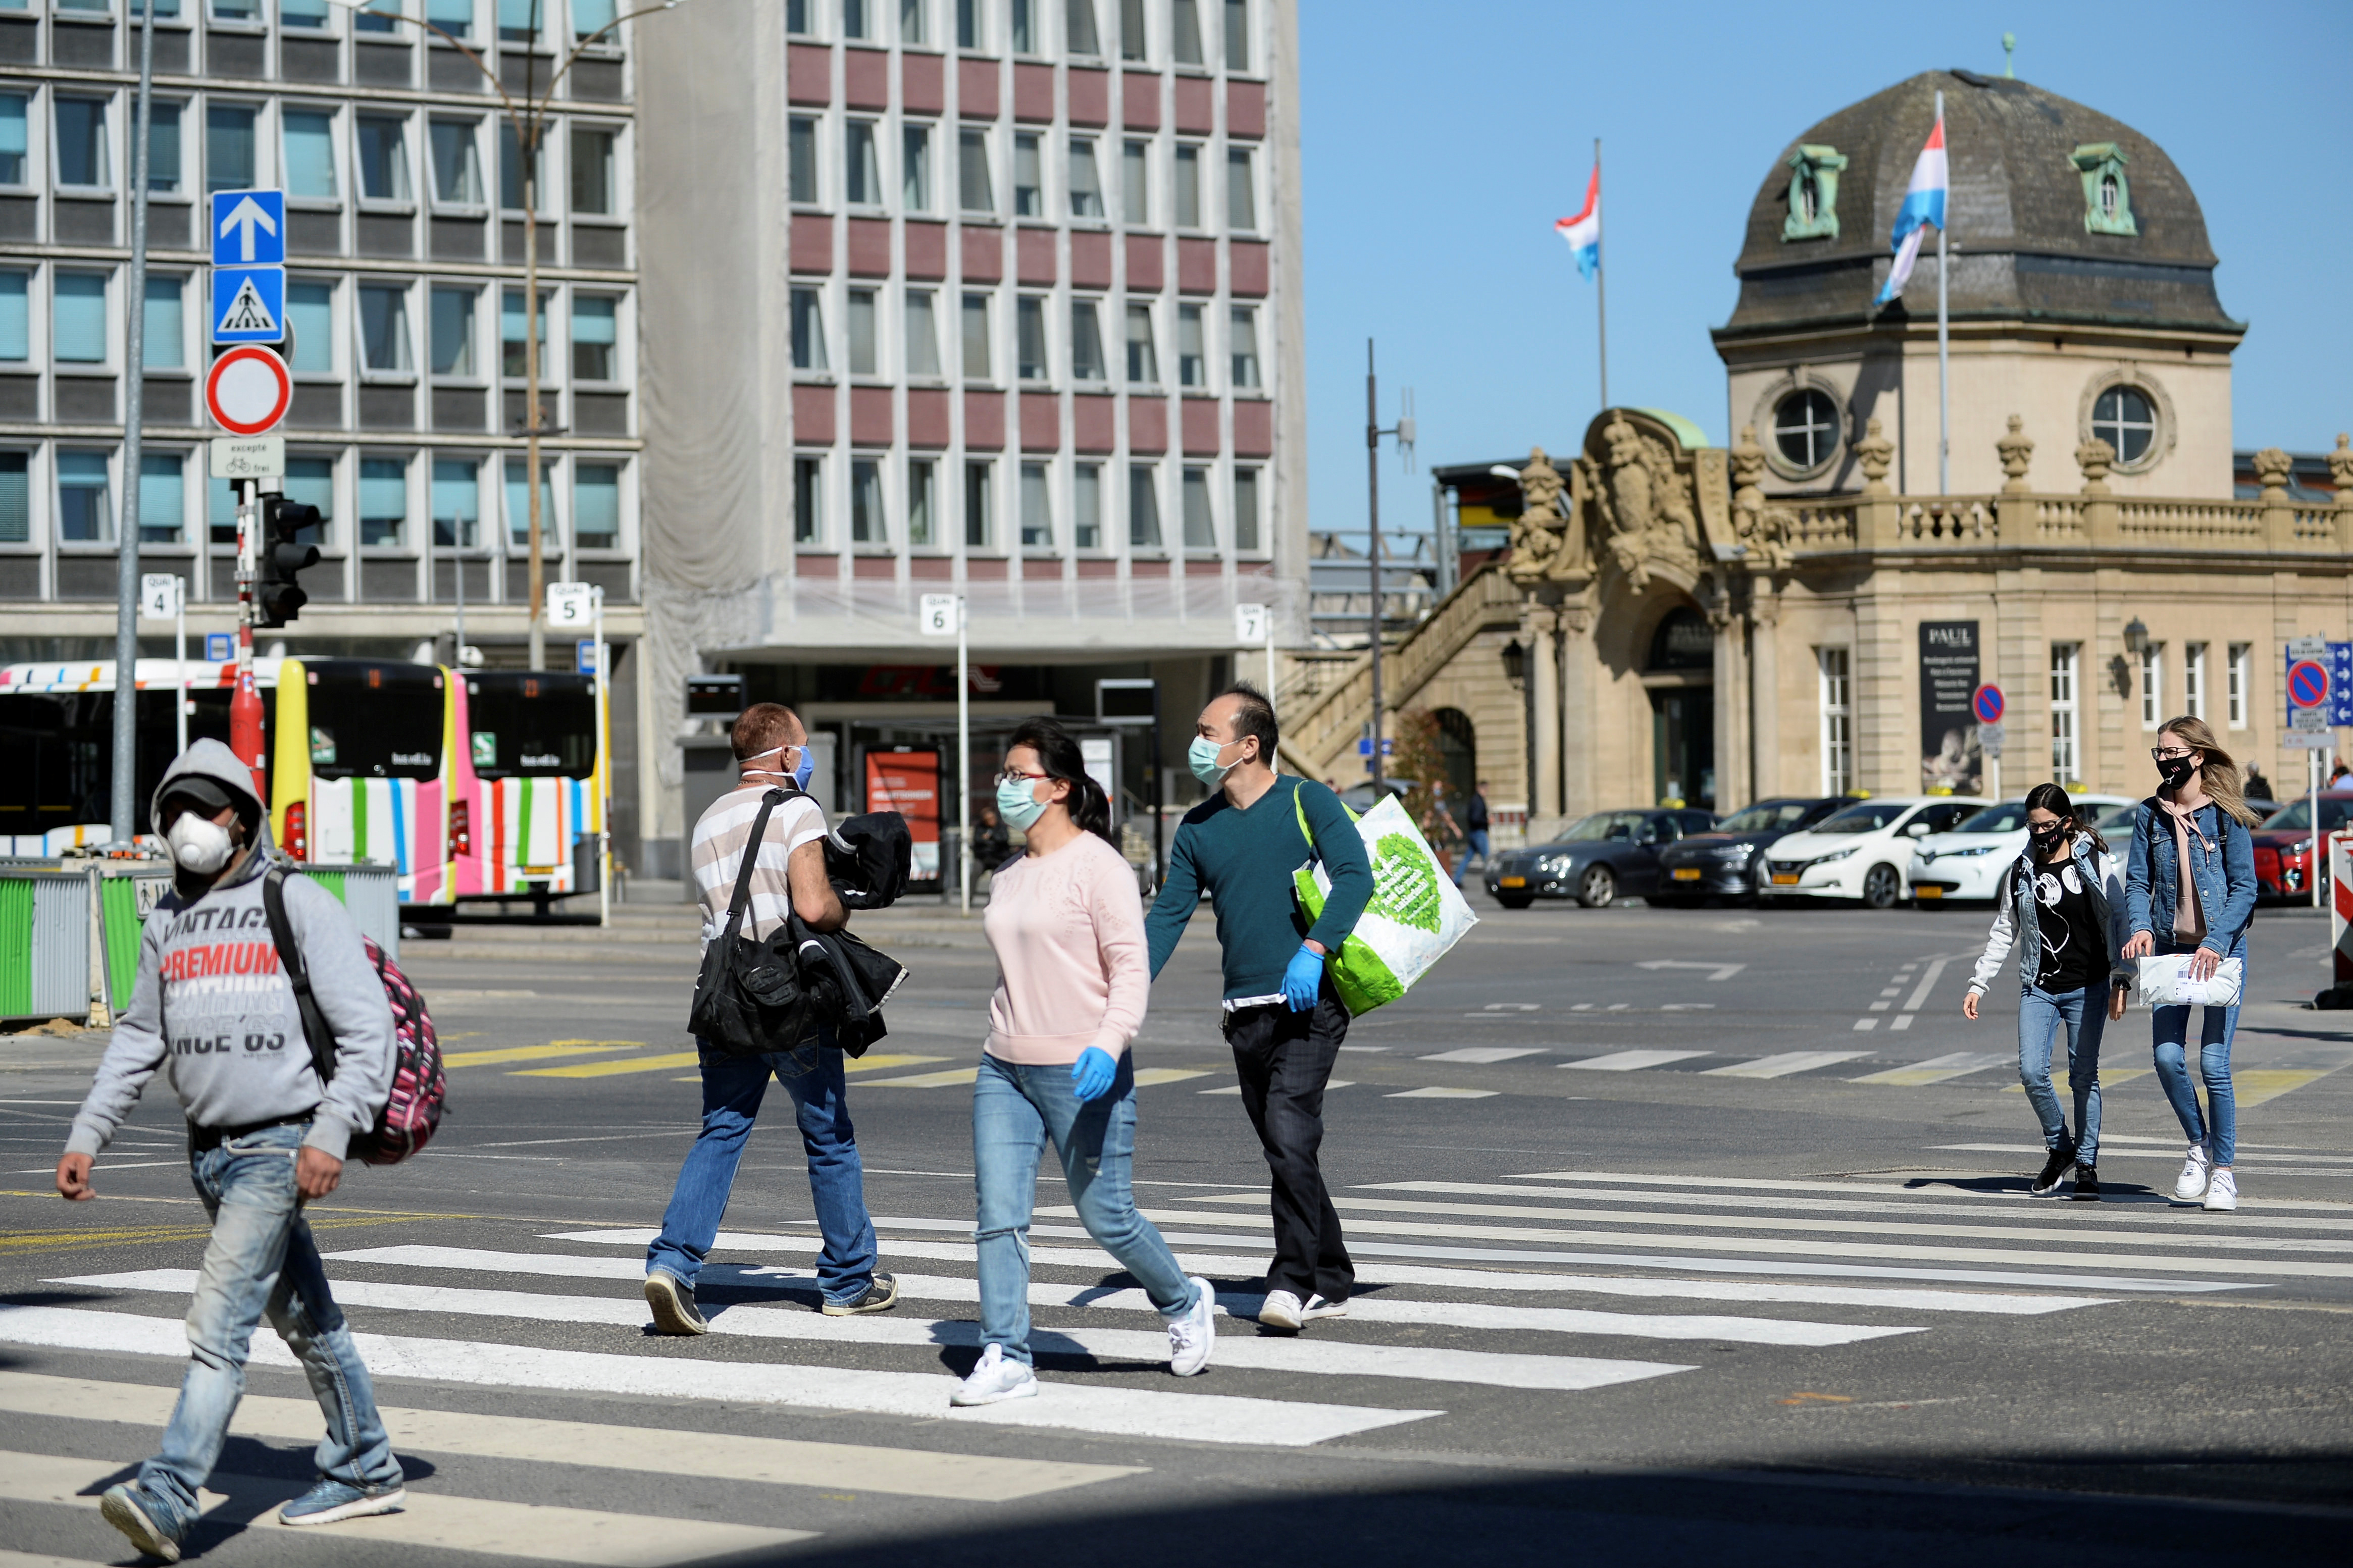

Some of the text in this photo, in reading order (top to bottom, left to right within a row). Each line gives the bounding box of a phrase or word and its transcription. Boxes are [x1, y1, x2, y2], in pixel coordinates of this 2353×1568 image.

[231, 444, 267, 453] excepté
[253, 463, 269, 472] frei
[148, 577, 171, 587] QUAI
[154, 594, 165, 611] 4
[564, 601, 575, 618] 5
[934, 610, 945, 629] 6
[1247, 619, 1255, 635] 7
[1928, 628, 1972, 645] PAUL
[160, 942, 280, 982] PREMIUM
